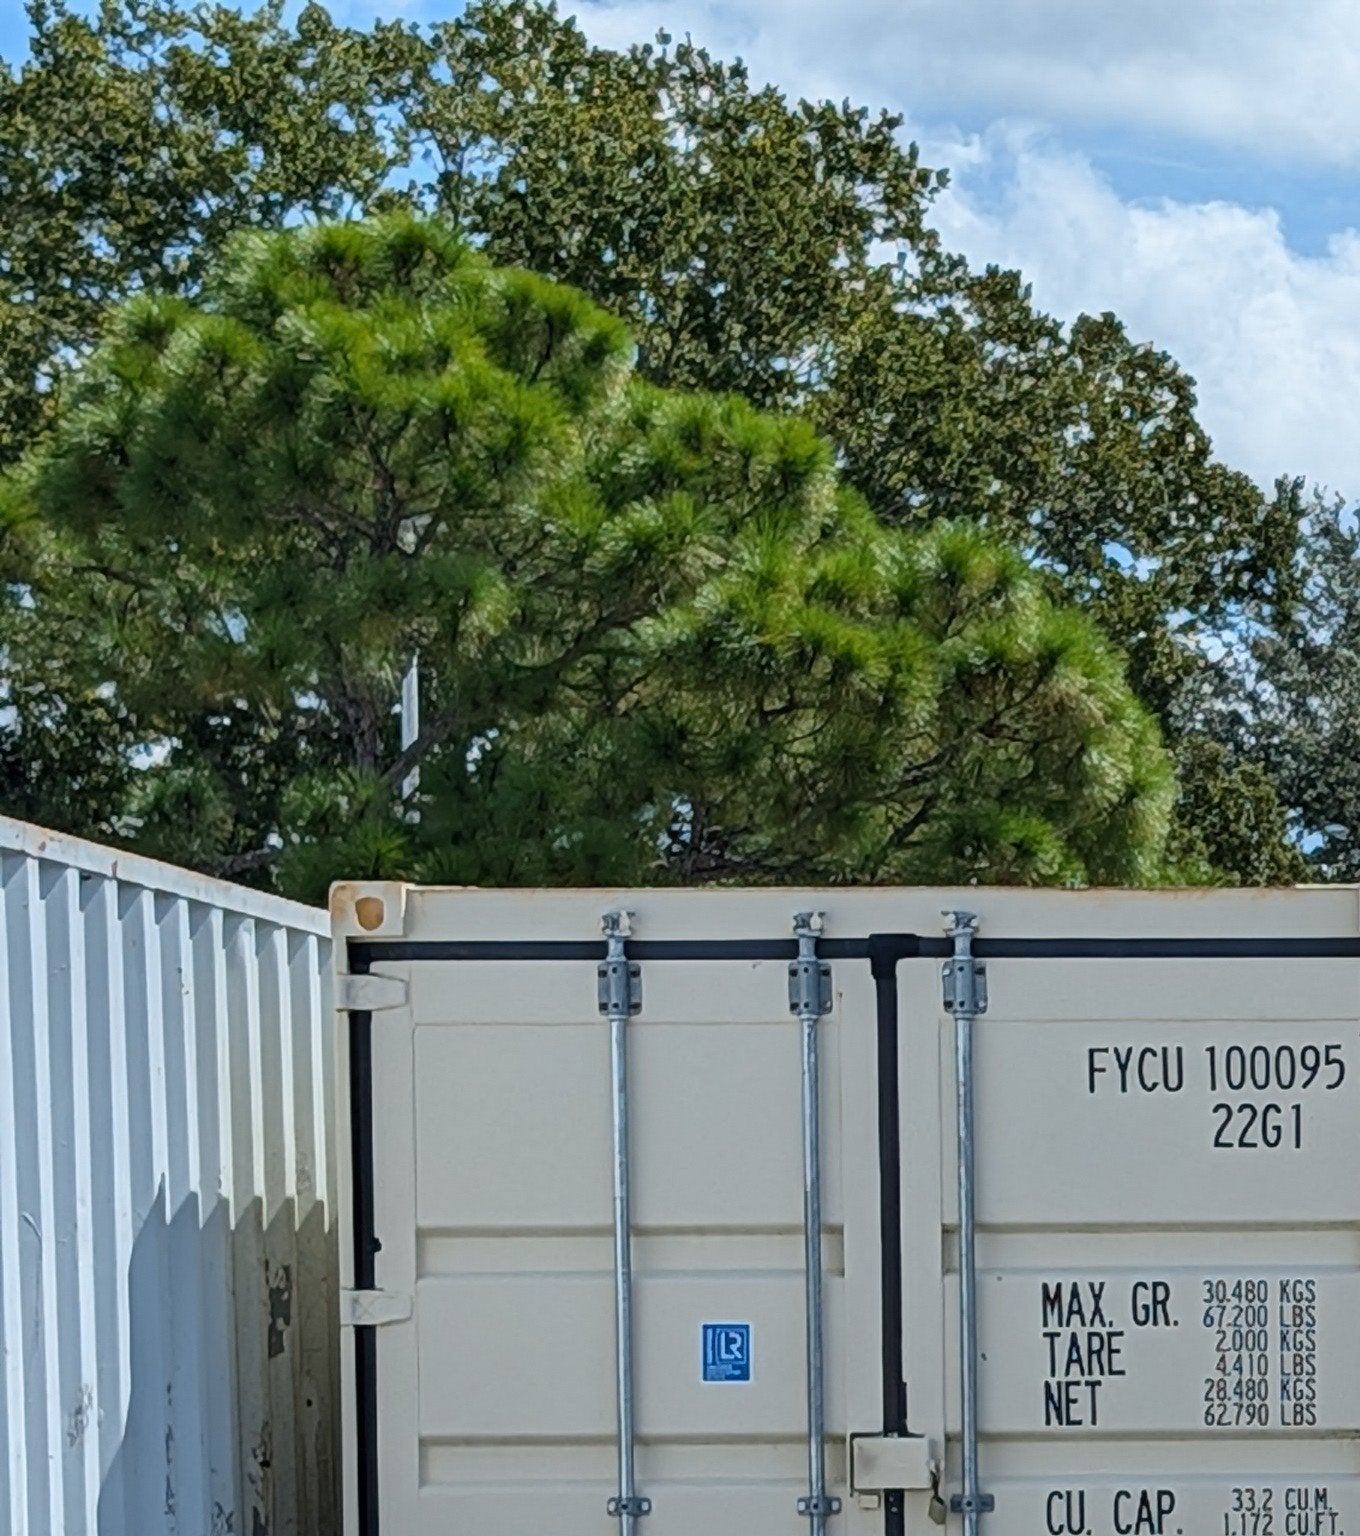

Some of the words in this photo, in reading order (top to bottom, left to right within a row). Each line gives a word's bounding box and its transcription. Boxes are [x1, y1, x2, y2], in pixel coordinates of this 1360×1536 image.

[1088, 1045, 1184, 1093] FYCU
[1204, 1044, 1346, 1092] 100095
[1212, 1102, 1302, 1149] 22G1
[1041, 1281, 1114, 1328] MAX.
[1132, 1280, 1180, 1327] GR.
[1279, 1279, 1317, 1303] KGS
[1279, 1304, 1317, 1328] LBS
[1042, 1330, 1127, 1378] TARE
[1279, 1329, 1317, 1352] KGS
[1280, 1353, 1317, 1377] LBS
[1044, 1379, 1103, 1427] NET
[1280, 1378, 1317, 1401] KGS
[1280, 1402, 1318, 1427] LBS
[1046, 1489, 1093, 1536] CU.
[1113, 1489, 1184, 1536] CAP.
